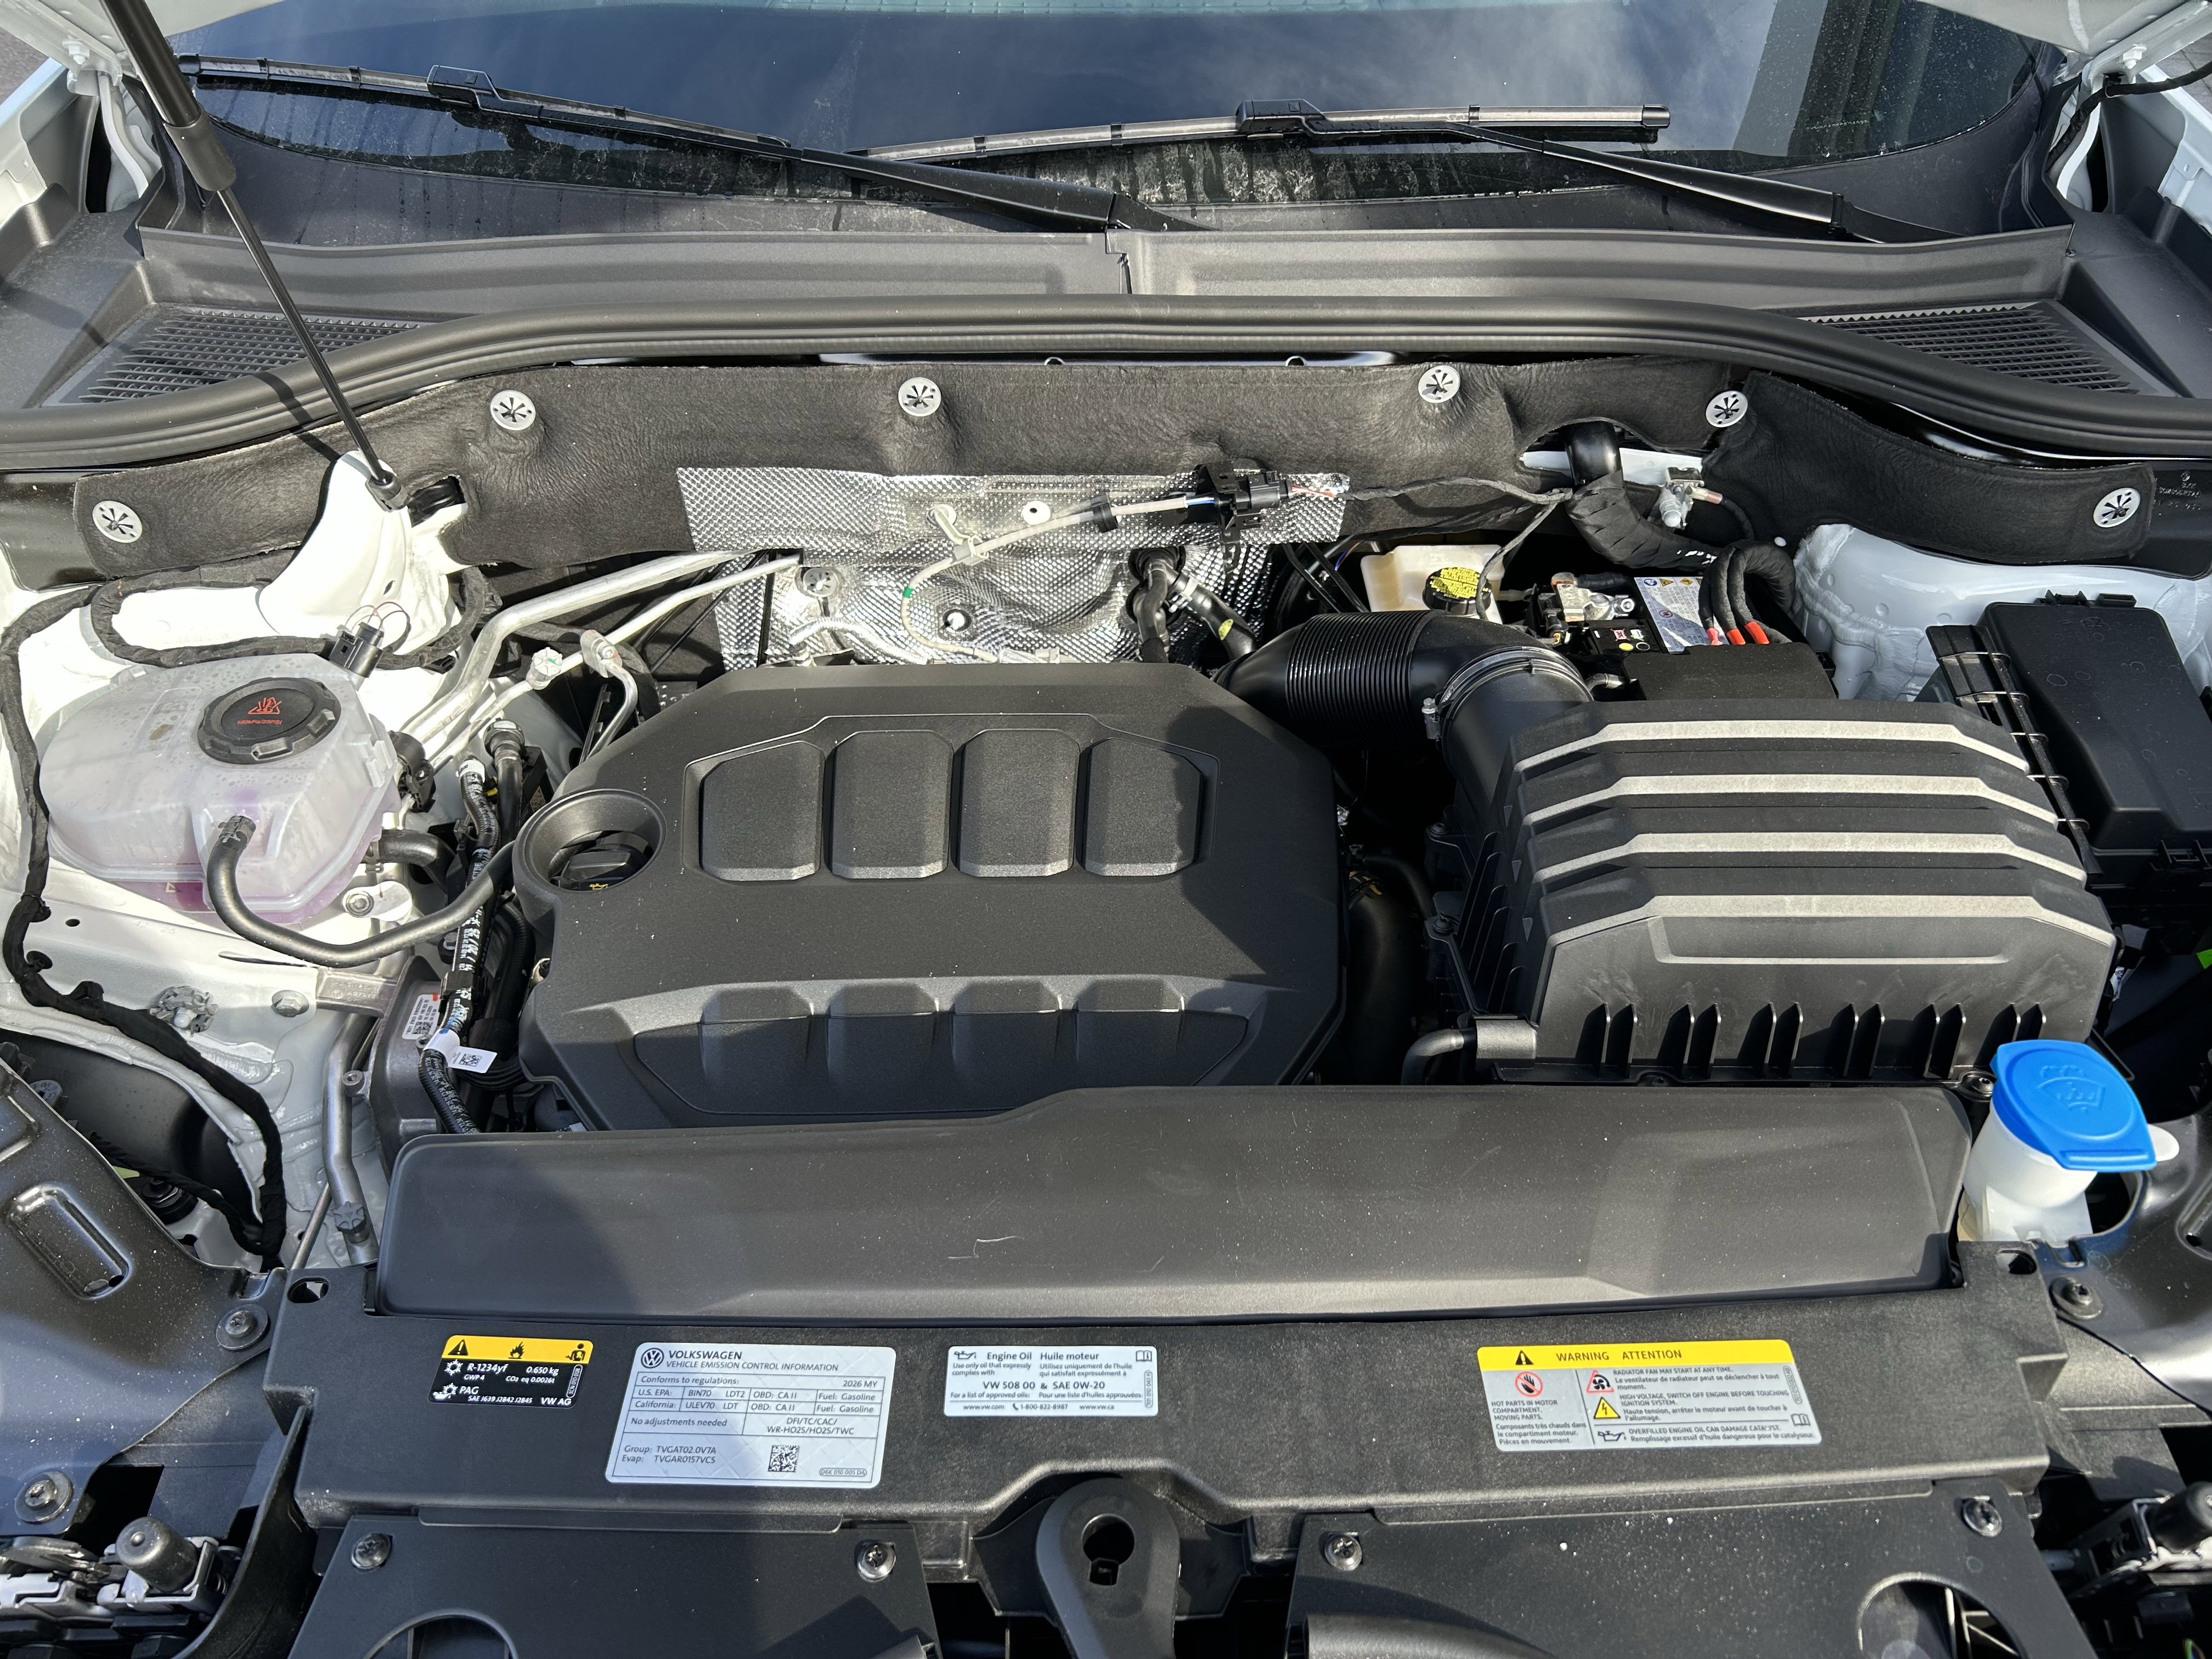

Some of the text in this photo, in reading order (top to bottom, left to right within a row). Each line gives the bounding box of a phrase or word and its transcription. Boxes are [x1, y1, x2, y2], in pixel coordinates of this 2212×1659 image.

[669, 1350, 742, 1359] VOLKSWAGEN
[987, 1352, 1017, 1361] Engine
[1555, 1350, 1681, 1361] WARNING ATTENTION
[467, 1363, 509, 1374] R-1234yf
[666, 1360, 698, 1368] VEHICLE
[781, 1363, 838, 1371] INFORMATION
[989, 1362, 1001, 1370] that
[549, 1367, 559, 1376] kg
[691, 1376, 739, 1385] regulations:
[1073, 1381, 1105, 1389] 0W-20
[459, 1386, 479, 1394] PAG
[841, 1392, 875, 1401] Gasoline
[816, 1404, 835, 1412] Fuel:
[644, 1417, 695, 1426] adjustments
[786, 1417, 837, 1425] DFI/TC/CAC/
[624, 1444, 652, 1454] Group:
[622, 1454, 644, 1463] Evap:
